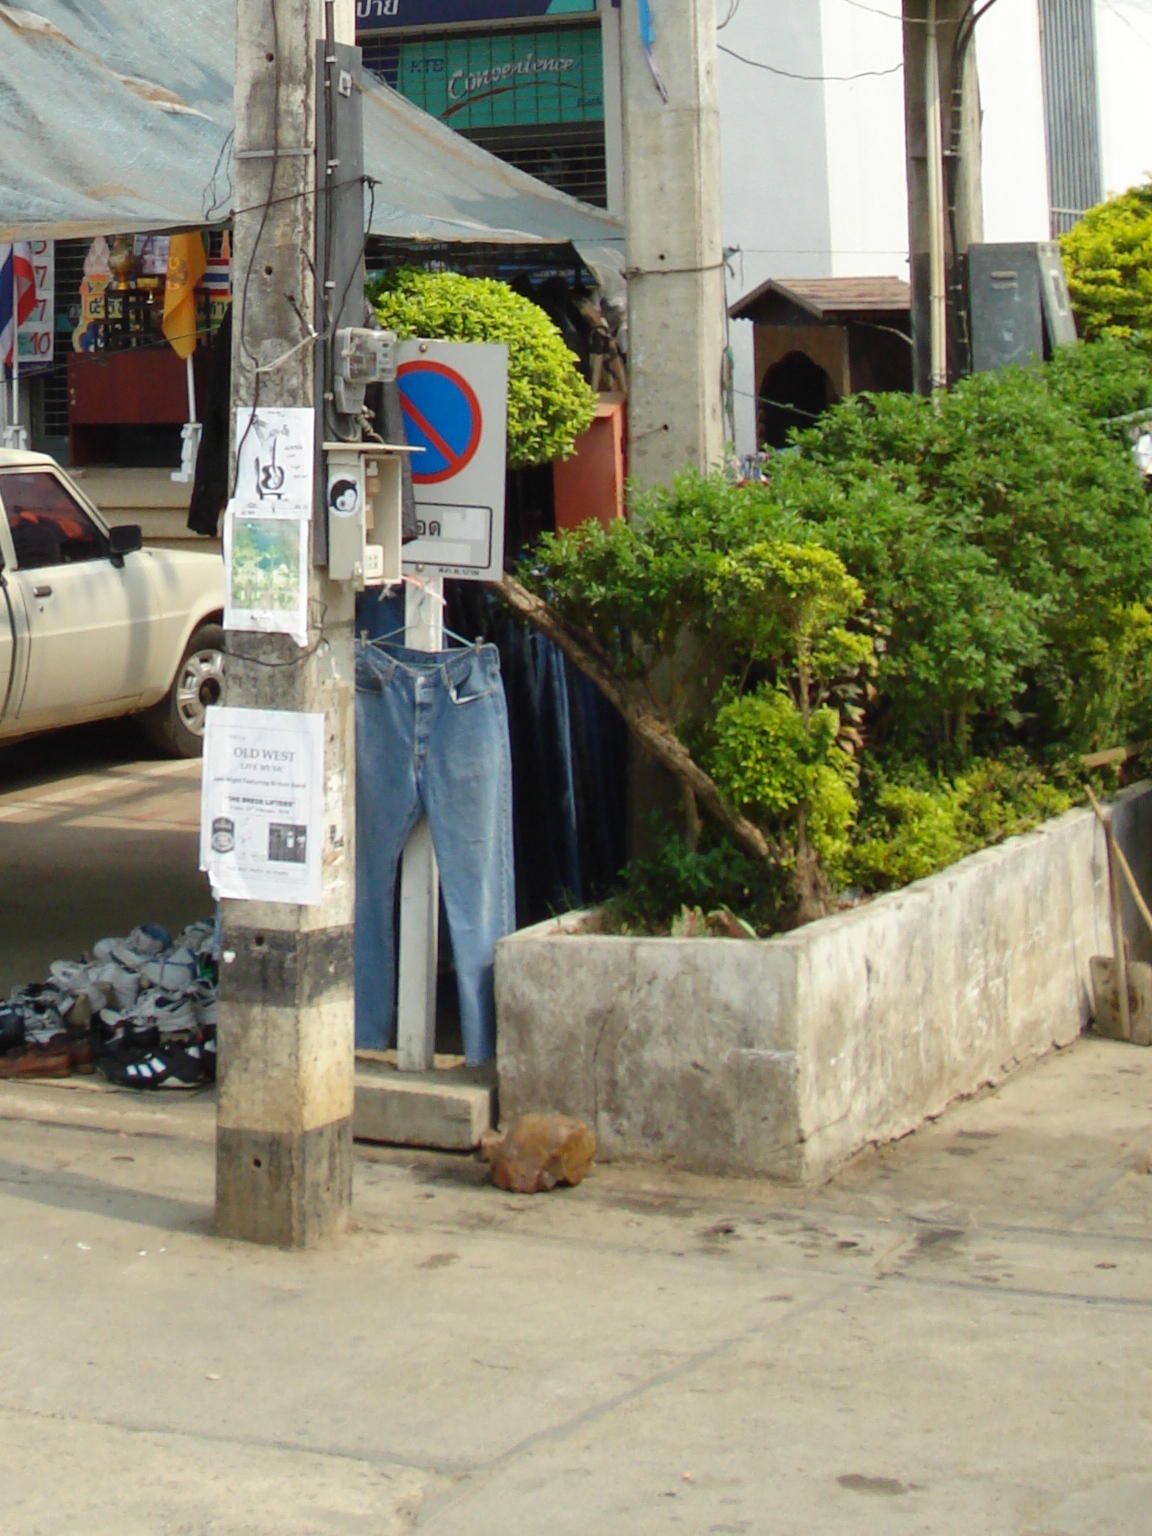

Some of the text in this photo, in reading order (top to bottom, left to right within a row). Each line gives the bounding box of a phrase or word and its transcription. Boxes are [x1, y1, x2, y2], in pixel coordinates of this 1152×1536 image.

[410, 58, 445, 74] KTB
[447, 52, 576, 100] Convenience
[35, 265, 48, 289] 7
[35, 298, 47, 322] 7
[29, 331, 51, 355] 10
[233, 746, 296, 762] OLD WEST
